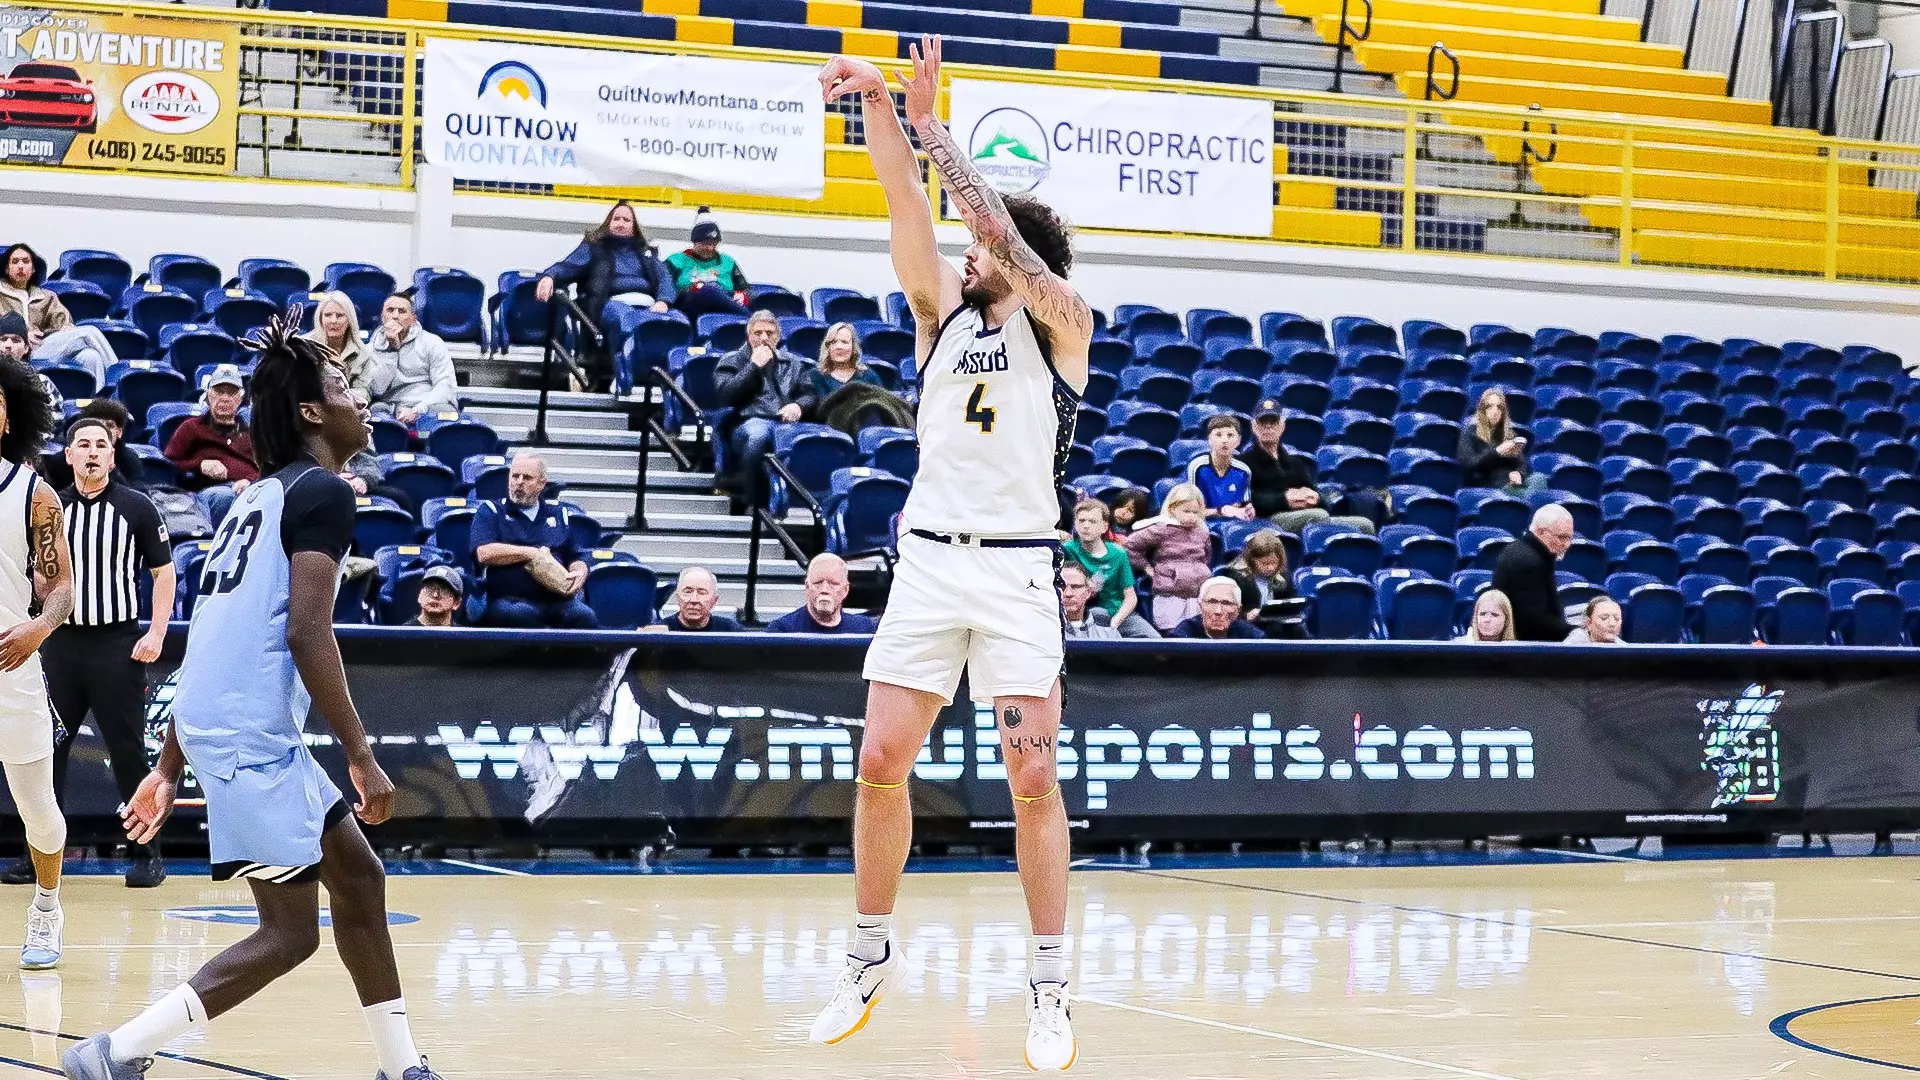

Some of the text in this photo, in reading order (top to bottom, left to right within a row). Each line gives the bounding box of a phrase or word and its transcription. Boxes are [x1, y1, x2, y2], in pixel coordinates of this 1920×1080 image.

[2, 13, 89, 29] DISCOVER
[31, 29, 224, 73] ADVENTURE
[131, 100, 207, 115] RENTAL
[597, 84, 804, 114] QuitNowMontana.com
[445, 112, 579, 143] QUITNOW
[597, 112, 671, 129] SMOKING
[687, 118, 744, 133] VAPING
[142, 142, 226, 165] 245-9055
[444, 140, 579, 169] MONTANA
[623, 137, 778, 162] 1-800-QUIT-NOW
[1053, 121, 1265, 164] CHIROPRACTIC
[1119, 162, 1199, 196] FIRST
[953, 342, 1009, 374] MSUB
[964, 382, 998, 435] 4
[199, 509, 264, 596] 23
[1009, 735, 1052, 755] 4:44
